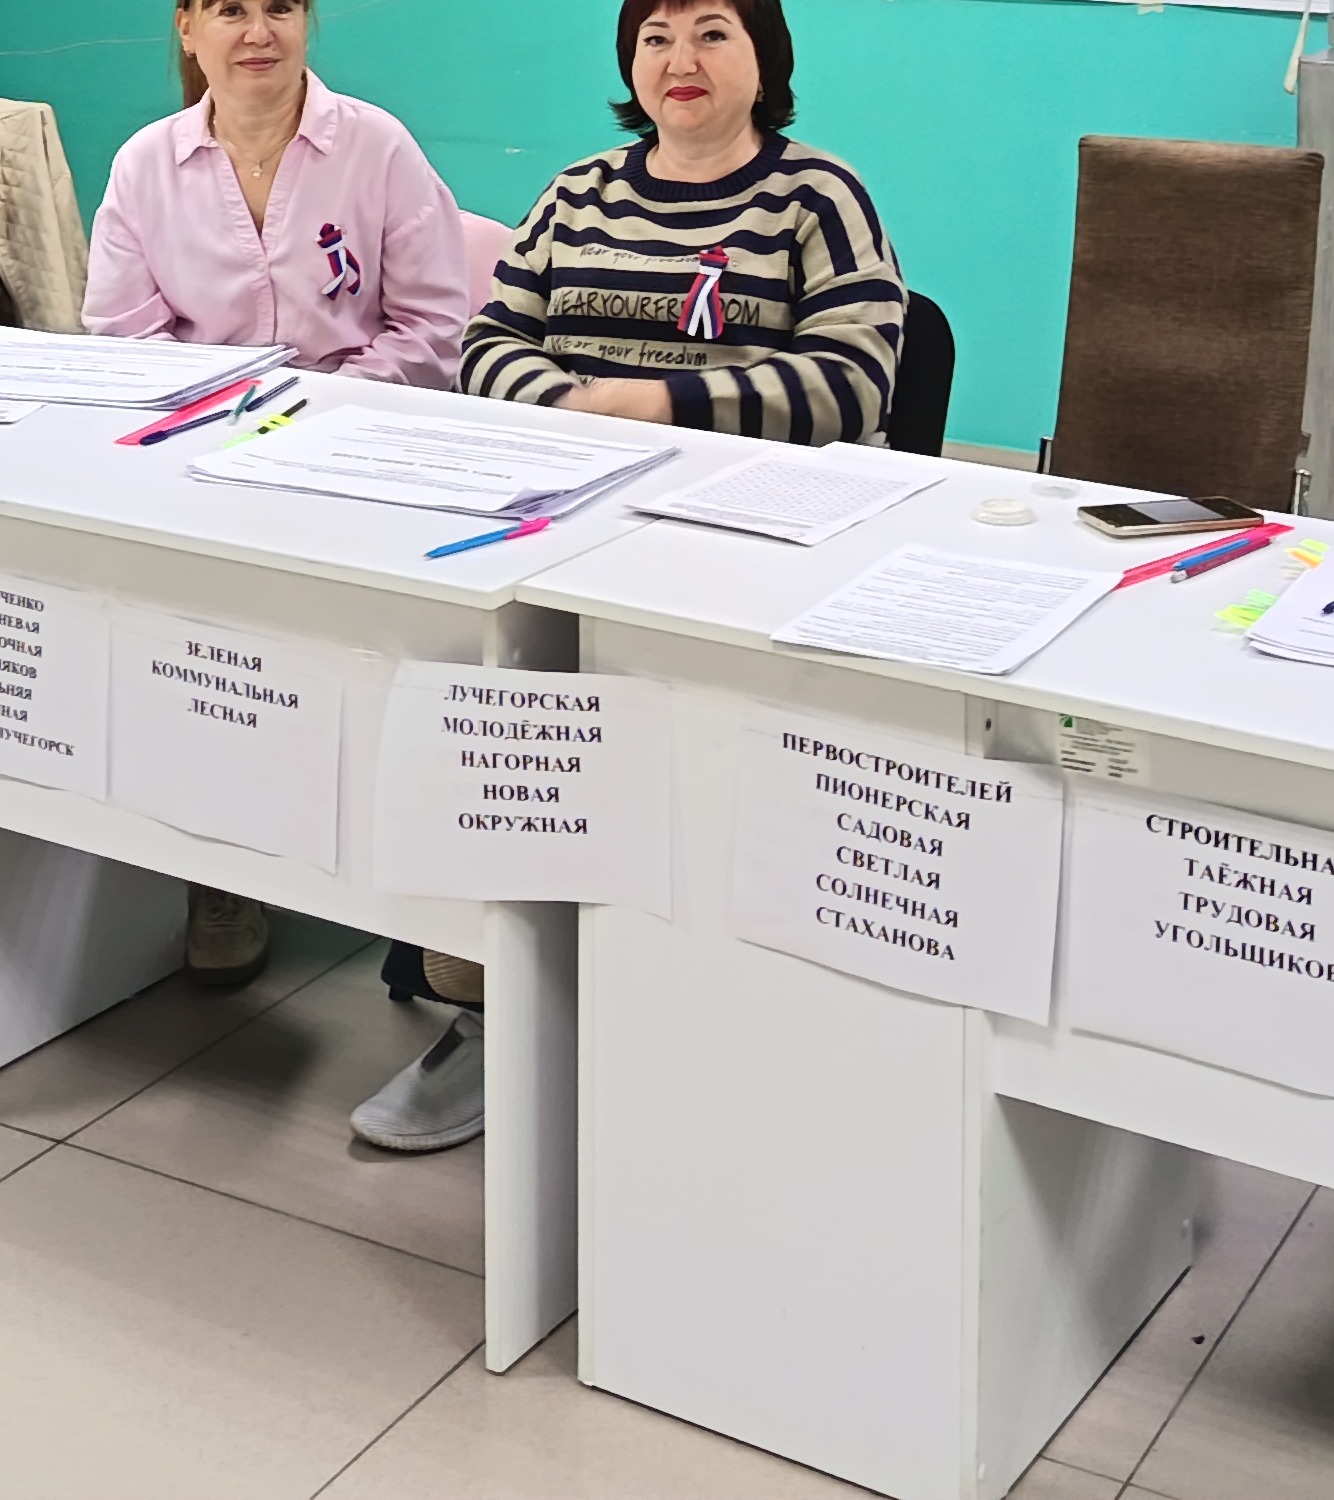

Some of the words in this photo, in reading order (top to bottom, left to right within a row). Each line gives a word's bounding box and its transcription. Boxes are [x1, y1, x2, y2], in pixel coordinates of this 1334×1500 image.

[185, 640, 263, 673] ЗЕЛЕНАЯ
[151, 659, 299, 710] КОММУНАЛЬНАЯ
[443, 683, 602, 713] ЛУЧЕГОРСКАЯ
[187, 697, 258, 729] ЛЕСНАЯ
[441, 716, 603, 744] МОЛОДЁЖНАЯ
[460, 750, 582, 774] НАГОРНАЯ
[782, 731, 1013, 804] ПЕРВОСТРОИТЕЛЕЙ
[482, 783, 561, 804] НОВАЯ
[815, 773, 971, 831] ПИОНЕРСКАЯ
[458, 812, 589, 835] ОКРУЖНАЯ
[836, 812, 943, 858] САДОВАЯ
[836, 845, 941, 891] СВЕТЛАЯ
[1184, 857, 1314, 906] ТАЁЖНАЯ
[815, 873, 959, 929] СОЛНЕЧНАЯ
[1177, 891, 1317, 943] ТРУДОВАЯ
[815, 906, 955, 961] СТАХАНОВА
